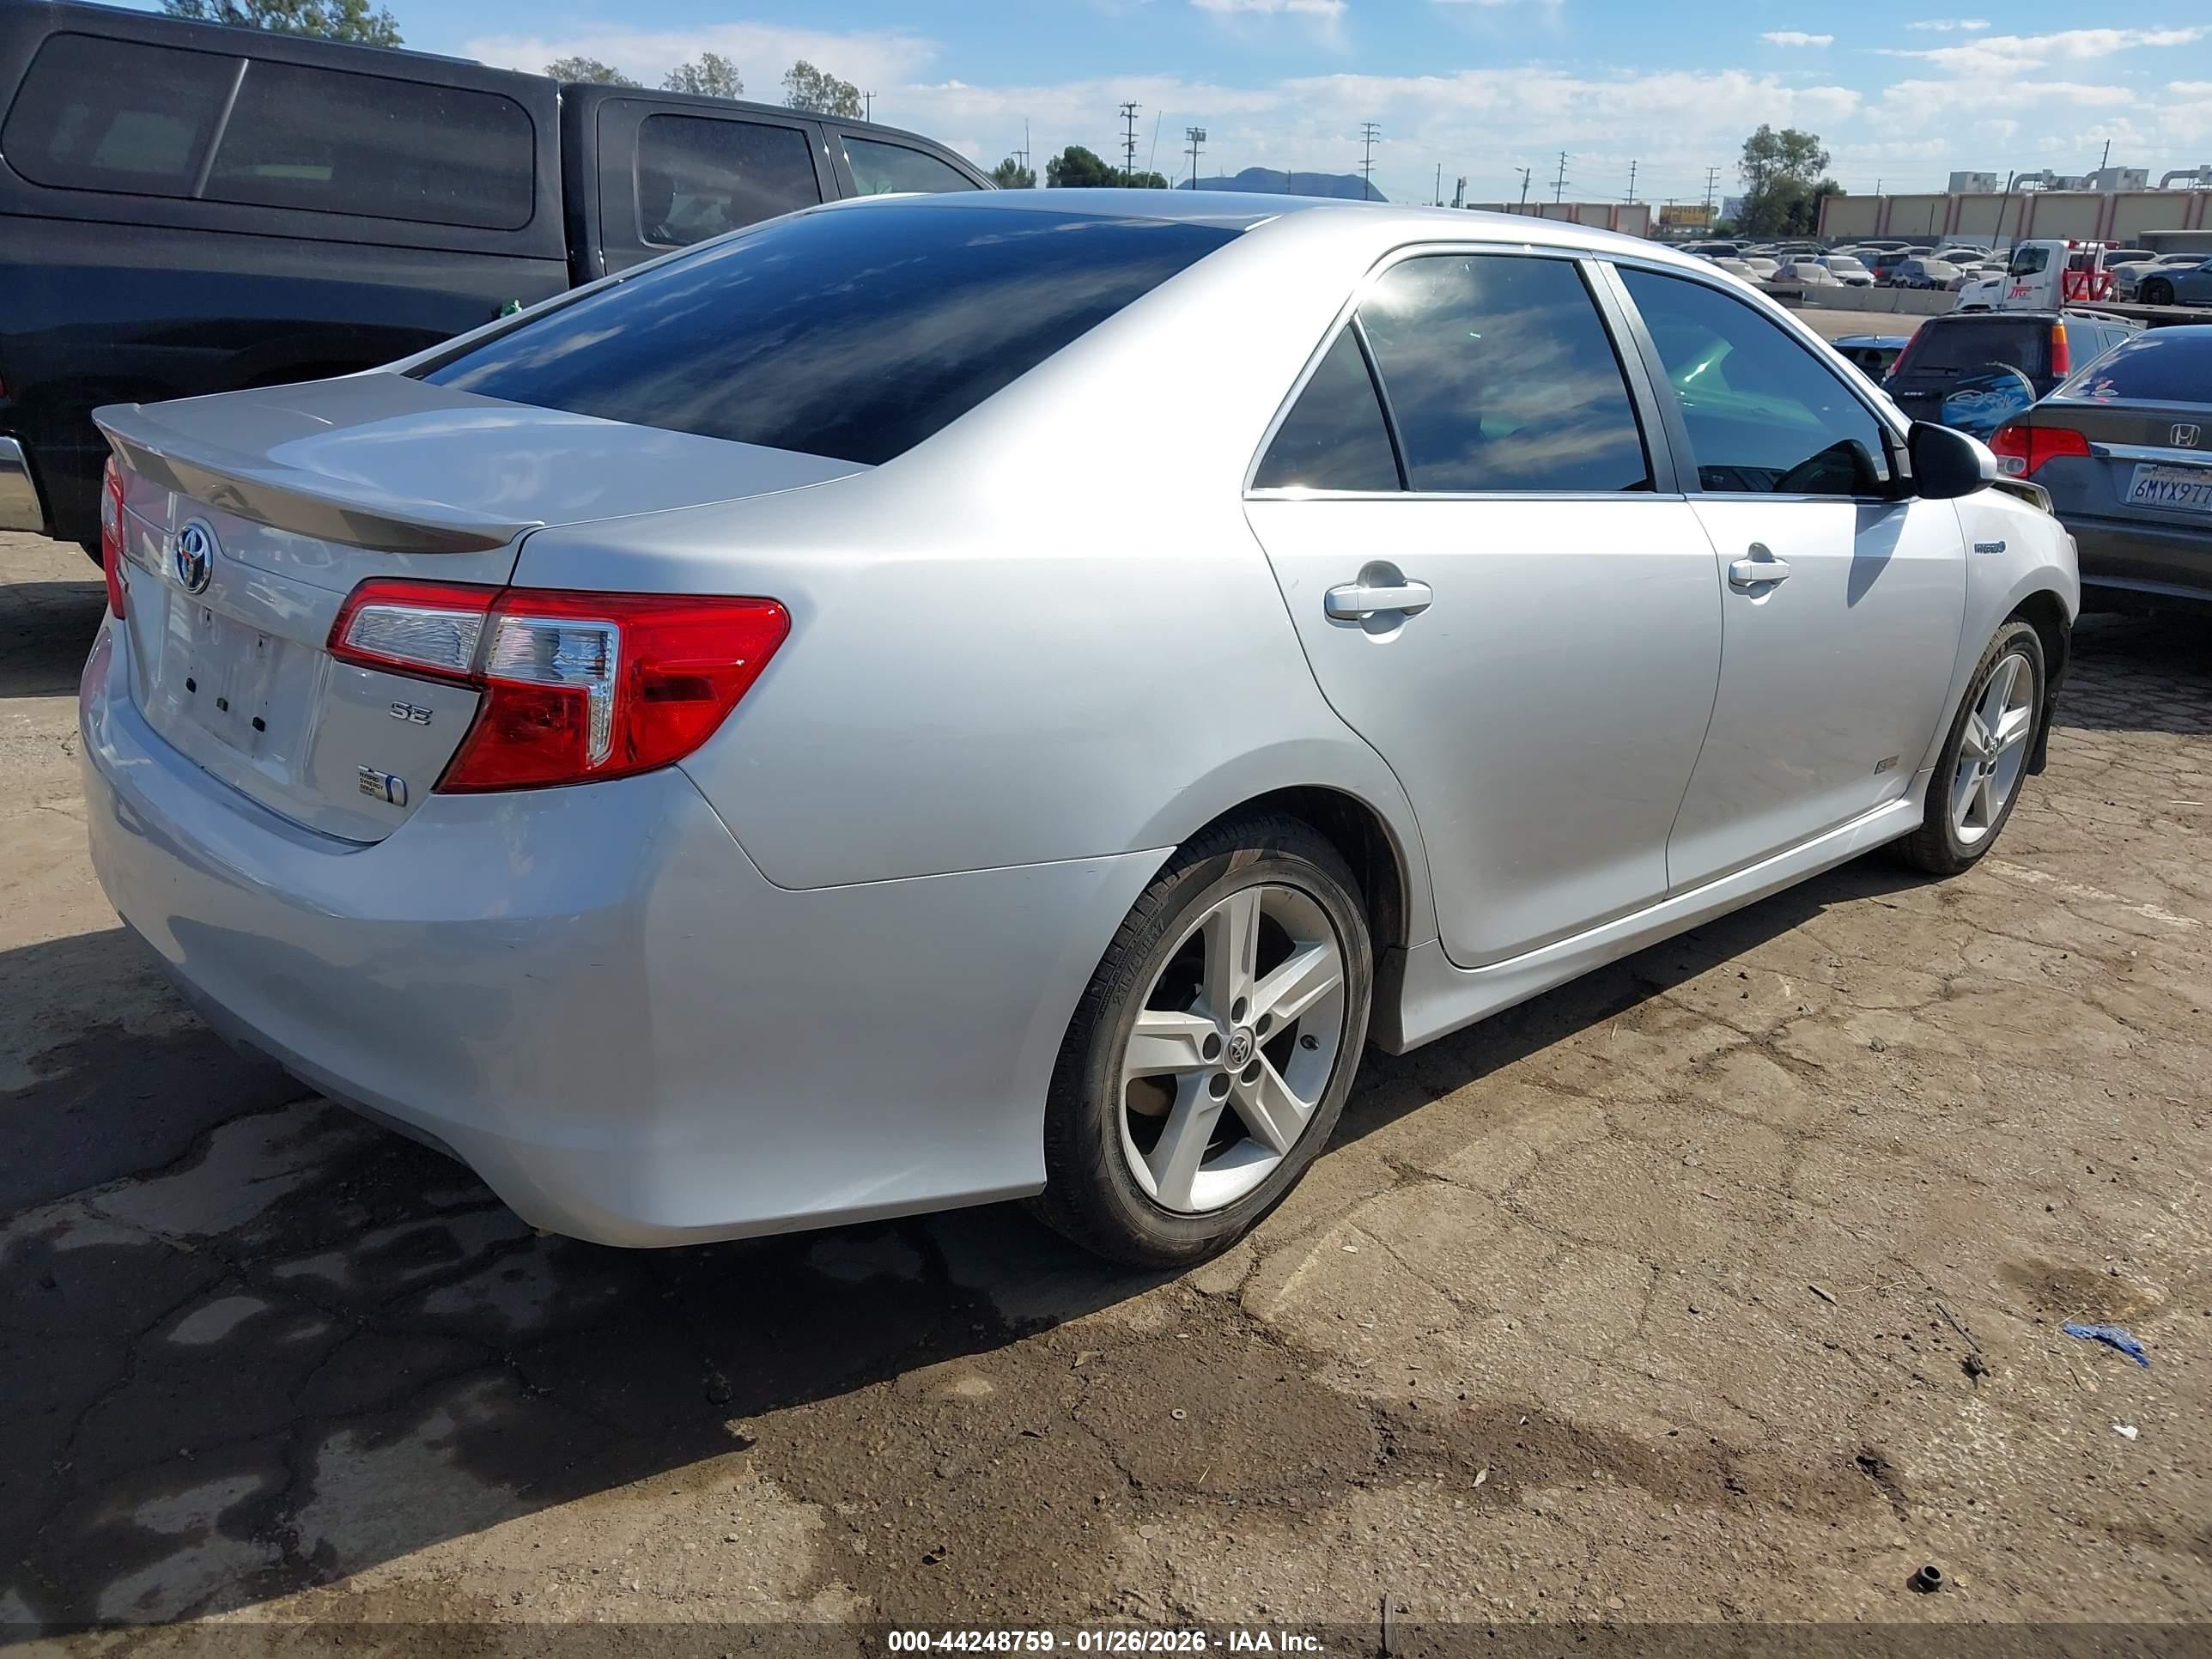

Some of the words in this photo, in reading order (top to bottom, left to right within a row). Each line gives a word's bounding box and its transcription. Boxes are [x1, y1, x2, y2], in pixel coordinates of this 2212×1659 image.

[2135, 479, 2212, 504] 6MYX977
[389, 700, 434, 726] SE
[359, 771, 379, 783] HYBRID
[359, 776, 383, 791] SYNERGY
